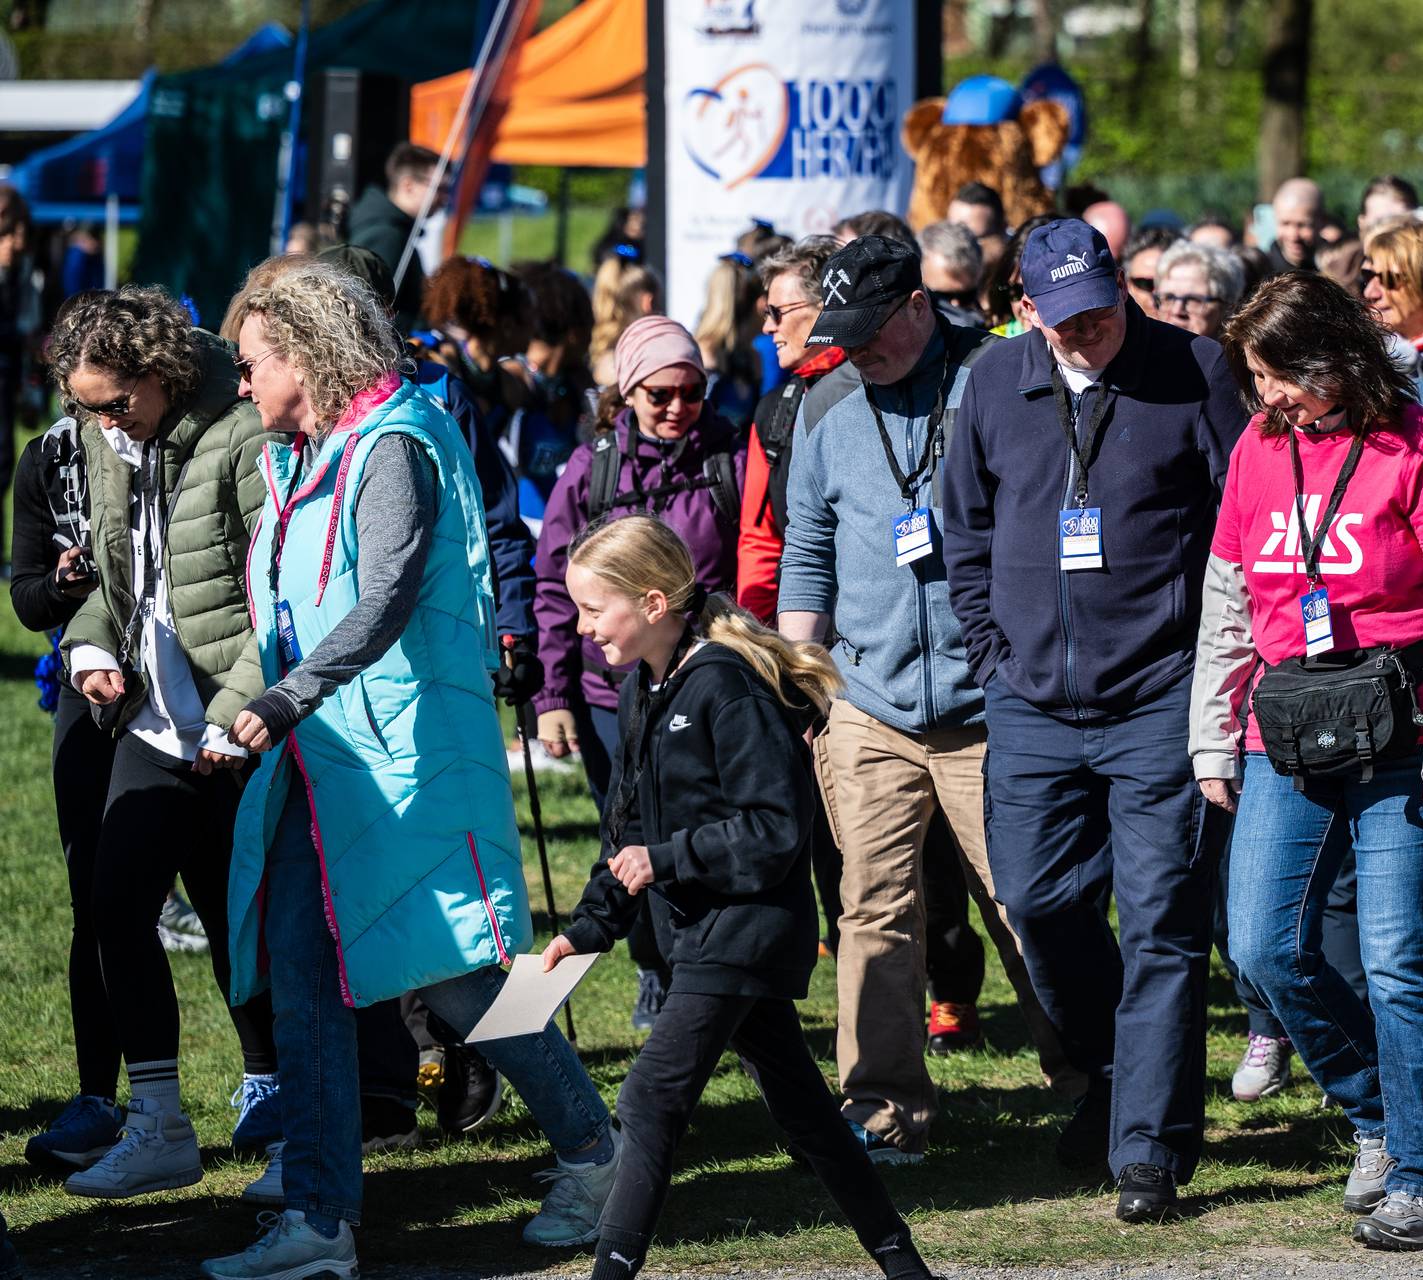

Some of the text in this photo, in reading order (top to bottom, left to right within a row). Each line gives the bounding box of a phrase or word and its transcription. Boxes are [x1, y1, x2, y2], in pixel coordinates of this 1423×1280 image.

[795, 78, 895, 133] 1000
[1050, 261, 1085, 282] PUMA
[336, 474, 346, 497] GOOD
[328, 518, 338, 541] GOOD
[319, 564, 330, 588] GOOD
